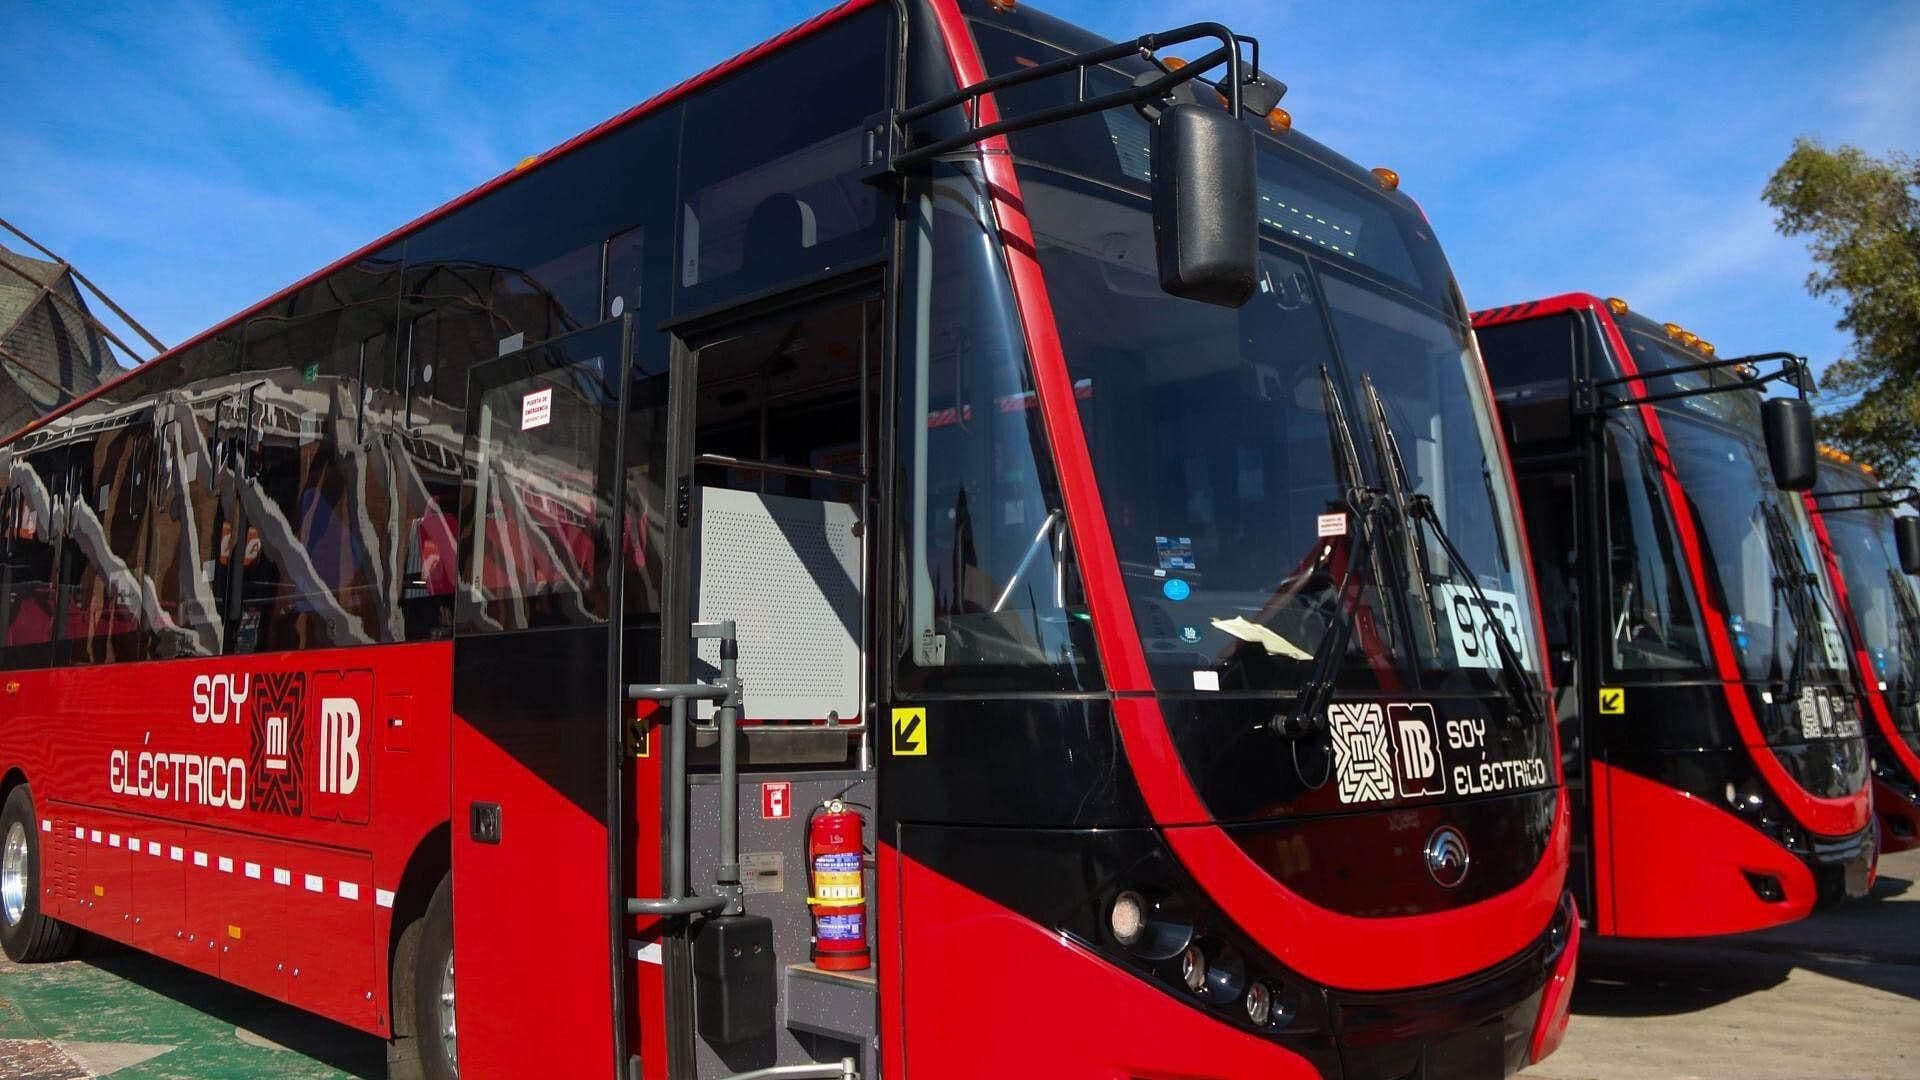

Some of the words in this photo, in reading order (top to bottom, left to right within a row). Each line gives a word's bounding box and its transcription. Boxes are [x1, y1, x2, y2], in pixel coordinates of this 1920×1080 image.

[192, 673, 249, 724] SOY
[319, 697, 361, 795] MB
[1398, 720, 1436, 780] MB
[1446, 719, 1486, 749] SOY
[110, 732, 246, 810] ELÉCTRICO
[1453, 751, 1545, 795] ELÉCTRICO
